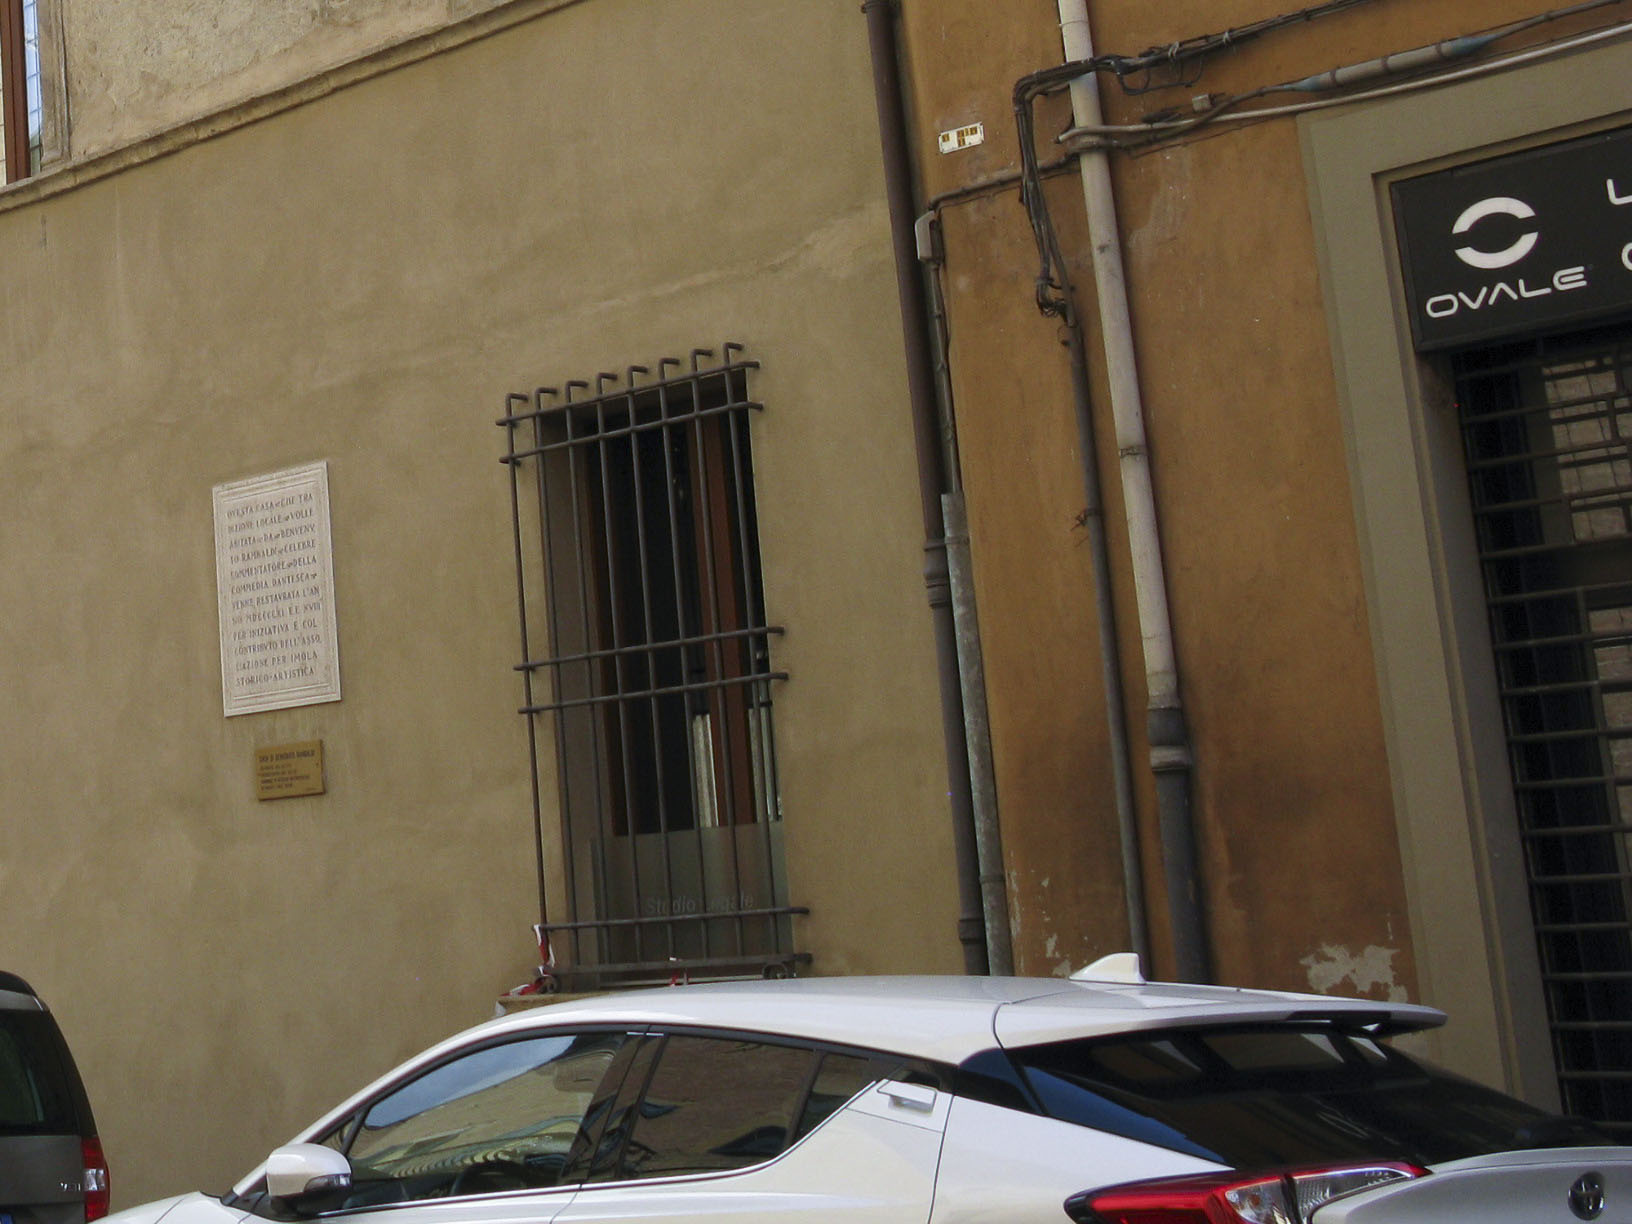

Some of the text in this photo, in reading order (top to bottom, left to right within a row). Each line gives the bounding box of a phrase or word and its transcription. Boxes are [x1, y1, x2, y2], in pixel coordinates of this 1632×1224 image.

[1426, 266, 1587, 318] OVALE
[255, 501, 275, 512] CASA
[280, 496, 295, 507] CHE
[299, 493, 313, 503] TRA
[256, 515, 282, 528] LOCALE
[288, 508, 313, 520] VOLLE
[263, 532, 273, 542] DA
[284, 539, 315, 553] CELEBRE
[230, 555, 317, 577] COMMENTATORE DELLA
[231, 573, 309, 595] COMMEDIA DANTESCA
[232, 598, 253, 610] VENNE
[233, 631, 246, 641] PER
[249, 624, 289, 639] INIZIATIVA
[302, 618, 318, 629] COL
[272, 656, 286, 666] PER
[290, 650, 318, 664] IMOLA
